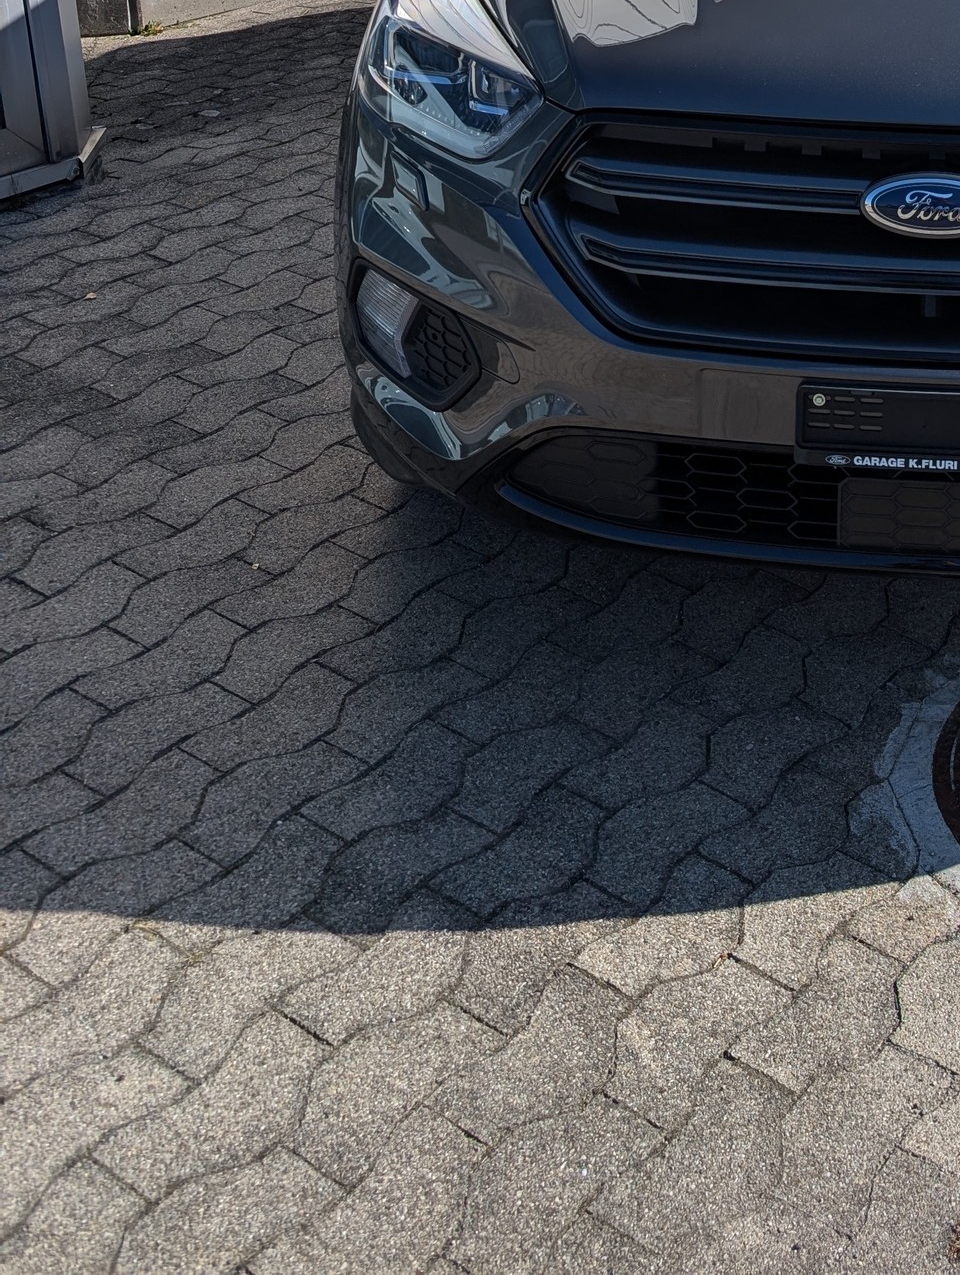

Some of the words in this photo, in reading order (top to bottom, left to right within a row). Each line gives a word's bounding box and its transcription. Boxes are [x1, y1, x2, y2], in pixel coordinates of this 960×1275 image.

[829, 456, 847, 464] Ford
[853, 455, 906, 468] GARAGE
[908, 458, 958, 470] K.FLURI
